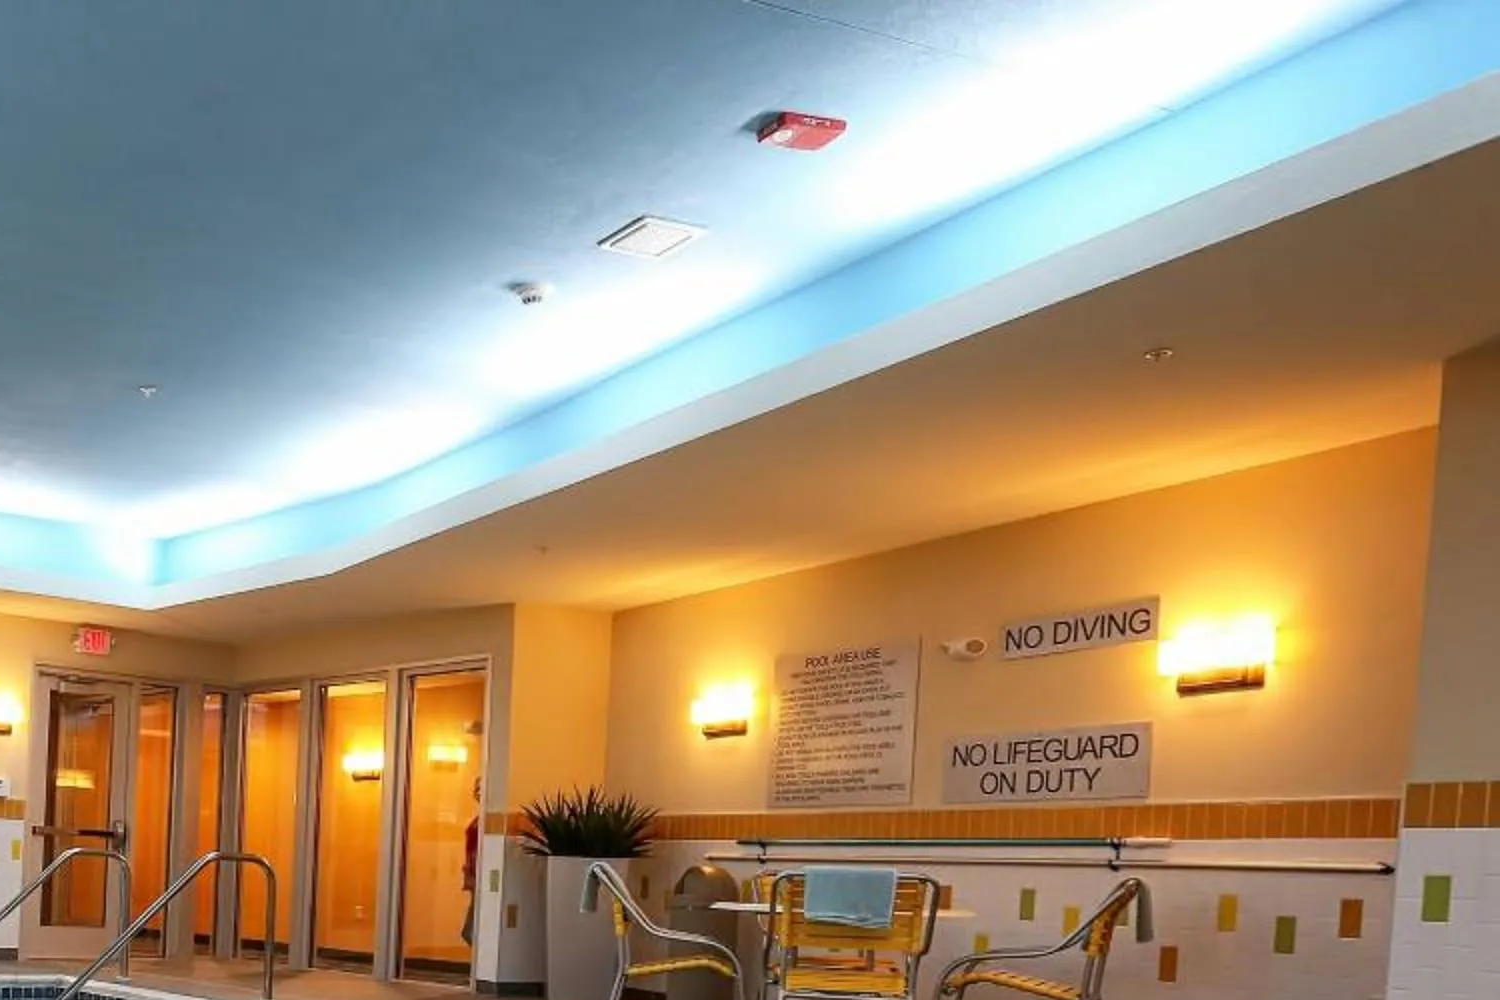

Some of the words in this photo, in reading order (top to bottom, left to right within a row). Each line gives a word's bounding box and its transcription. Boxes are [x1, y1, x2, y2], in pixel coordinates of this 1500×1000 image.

[1005, 624, 1044, 652] NO
[1053, 608, 1150, 645] DIVING
[952, 743, 987, 767] NO
[993, 733, 1139, 765] LIFEGUARD
[980, 771, 1016, 795] ON
[1027, 767, 1101, 793] DUTY
